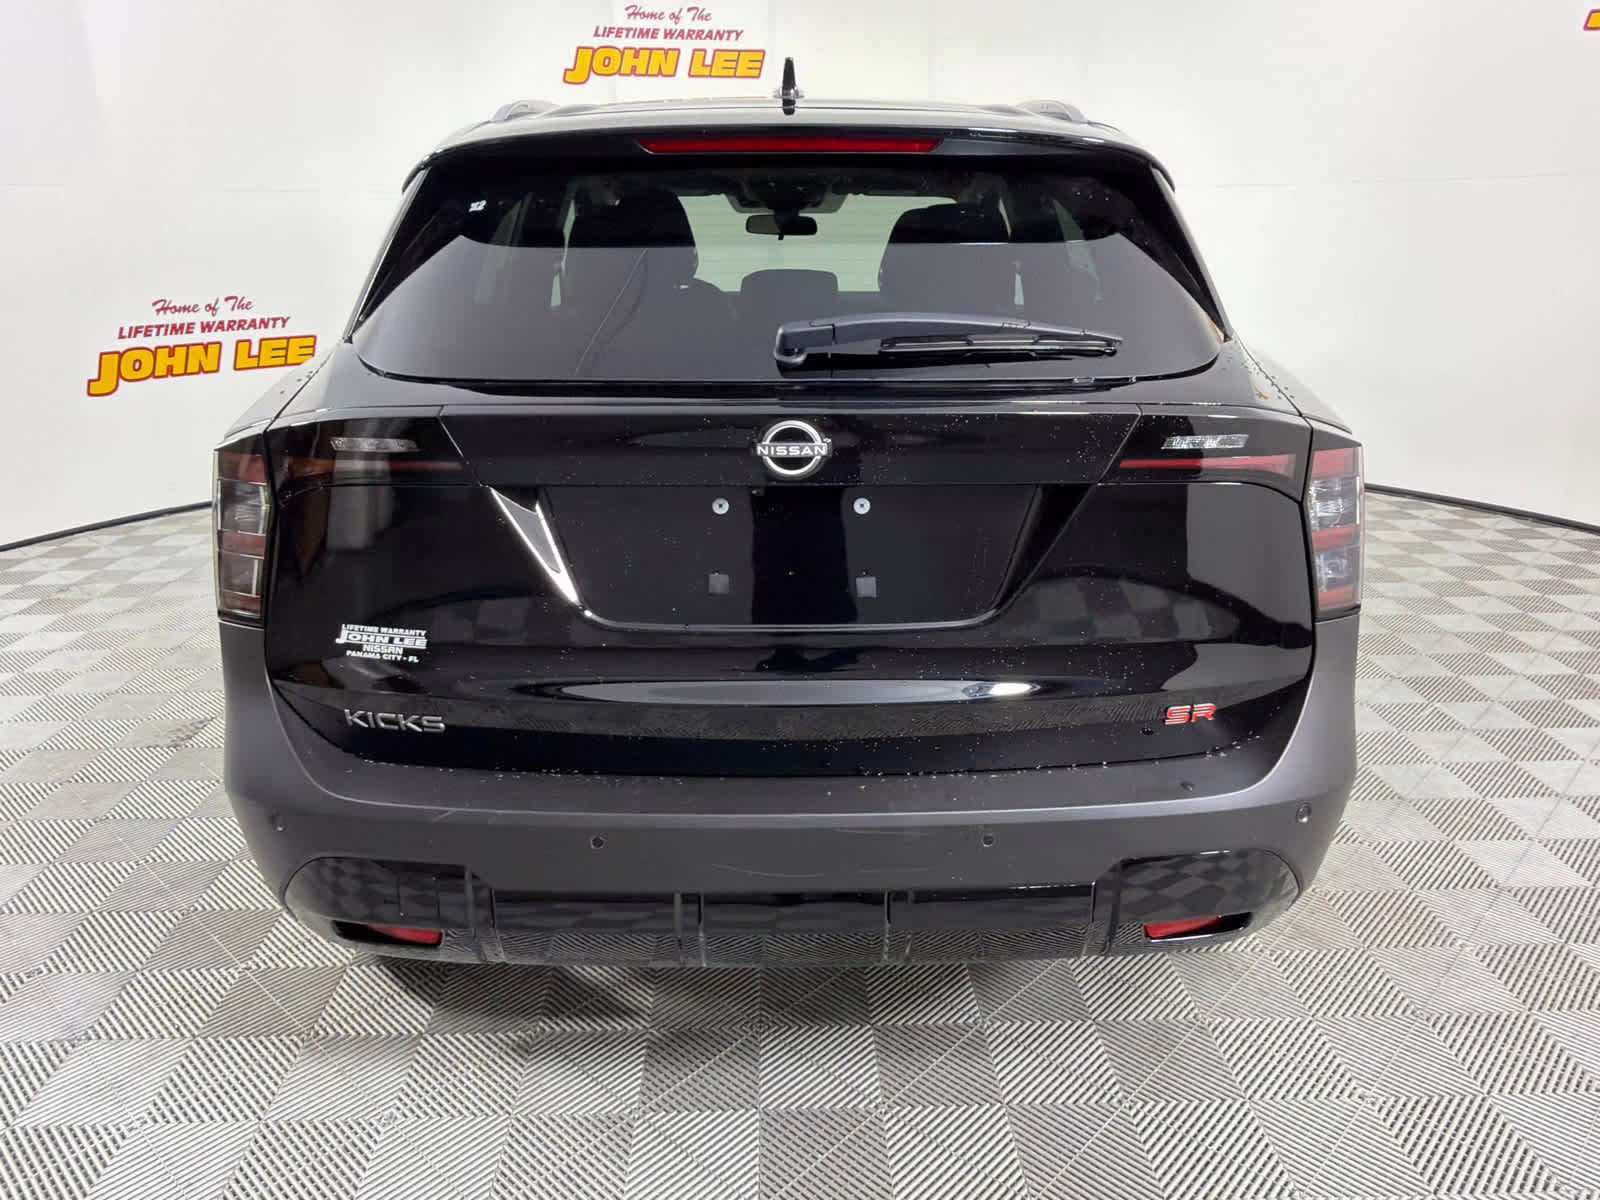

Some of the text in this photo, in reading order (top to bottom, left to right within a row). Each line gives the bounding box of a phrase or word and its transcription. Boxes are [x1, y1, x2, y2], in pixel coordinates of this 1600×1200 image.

[624, 5, 712, 24] Home of The
[593, 26, 744, 41] LIFETIME WARRANTY
[563, 45, 766, 84] JOHN LEE
[152, 295, 254, 317] Home of The
[117, 316, 291, 340] LIFETIME WARRANTY
[87, 334, 317, 397] JOHN LEE
[756, 444, 828, 456] NISSAN
[335, 629, 428, 648] JOHN LEE
[341, 623, 427, 636] LIFETIME WARRANTY
[346, 650, 381, 659] PANAMA
[382, 653, 402, 661] CITY
[408, 655, 419, 663] FL
[362, 644, 404, 655] NISSAN
[344, 708, 446, 732] KICKS
[1165, 703, 1217, 725] SR
